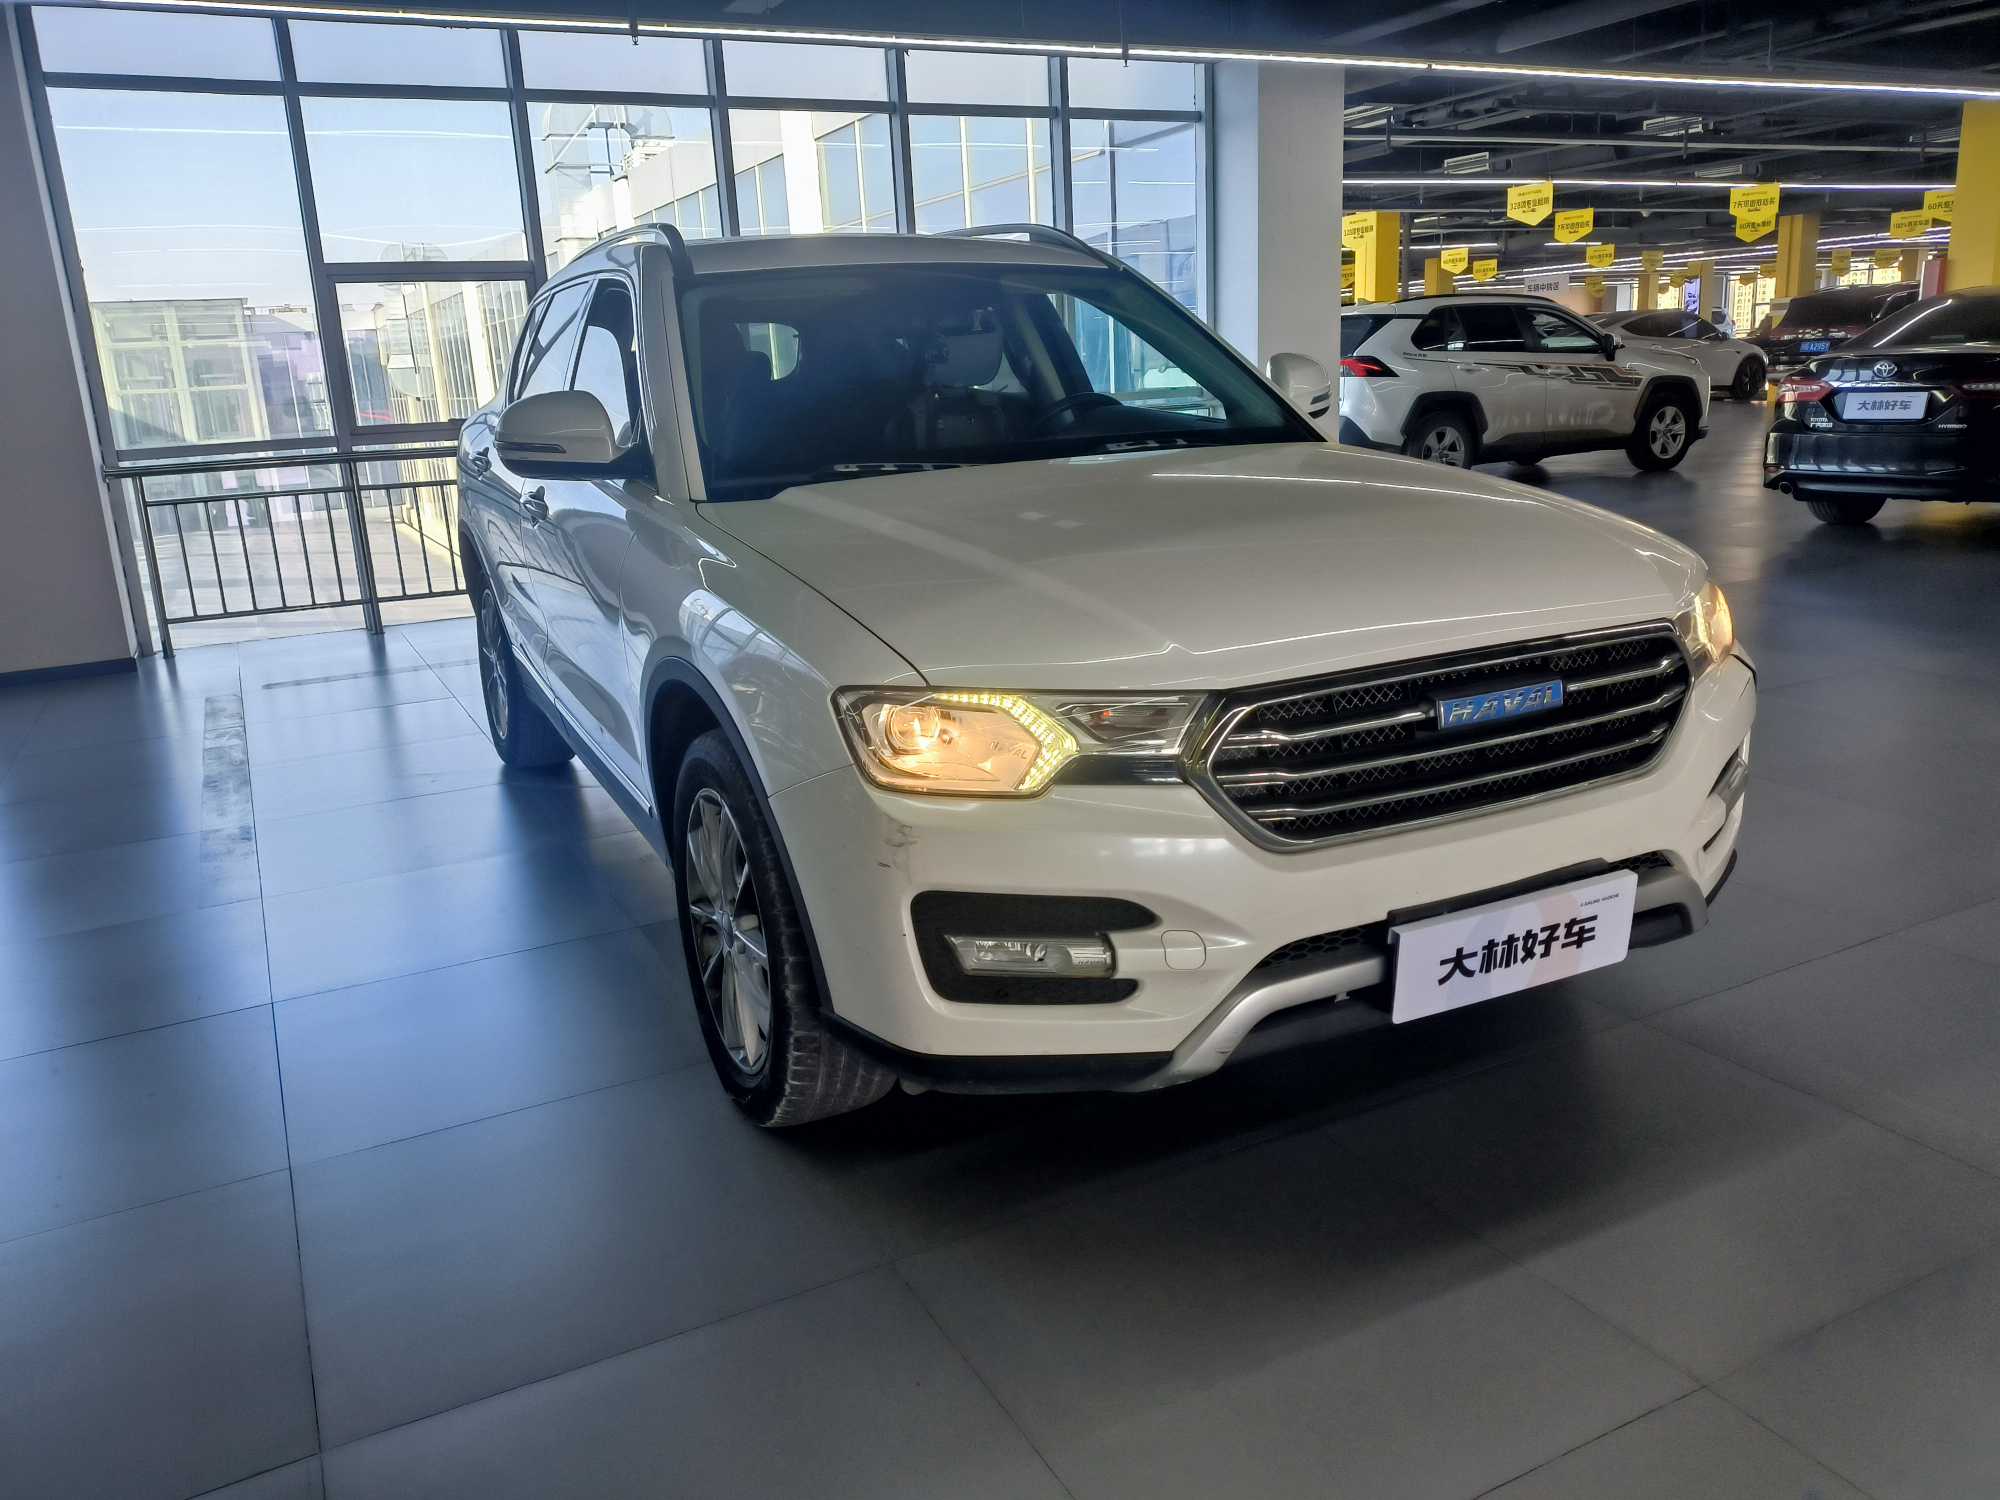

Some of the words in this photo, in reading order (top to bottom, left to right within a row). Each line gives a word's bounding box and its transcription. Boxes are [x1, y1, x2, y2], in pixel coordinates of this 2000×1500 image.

[1857, 400, 1912, 411] 大林好车
[1437, 914, 1598, 986] 大林好车
